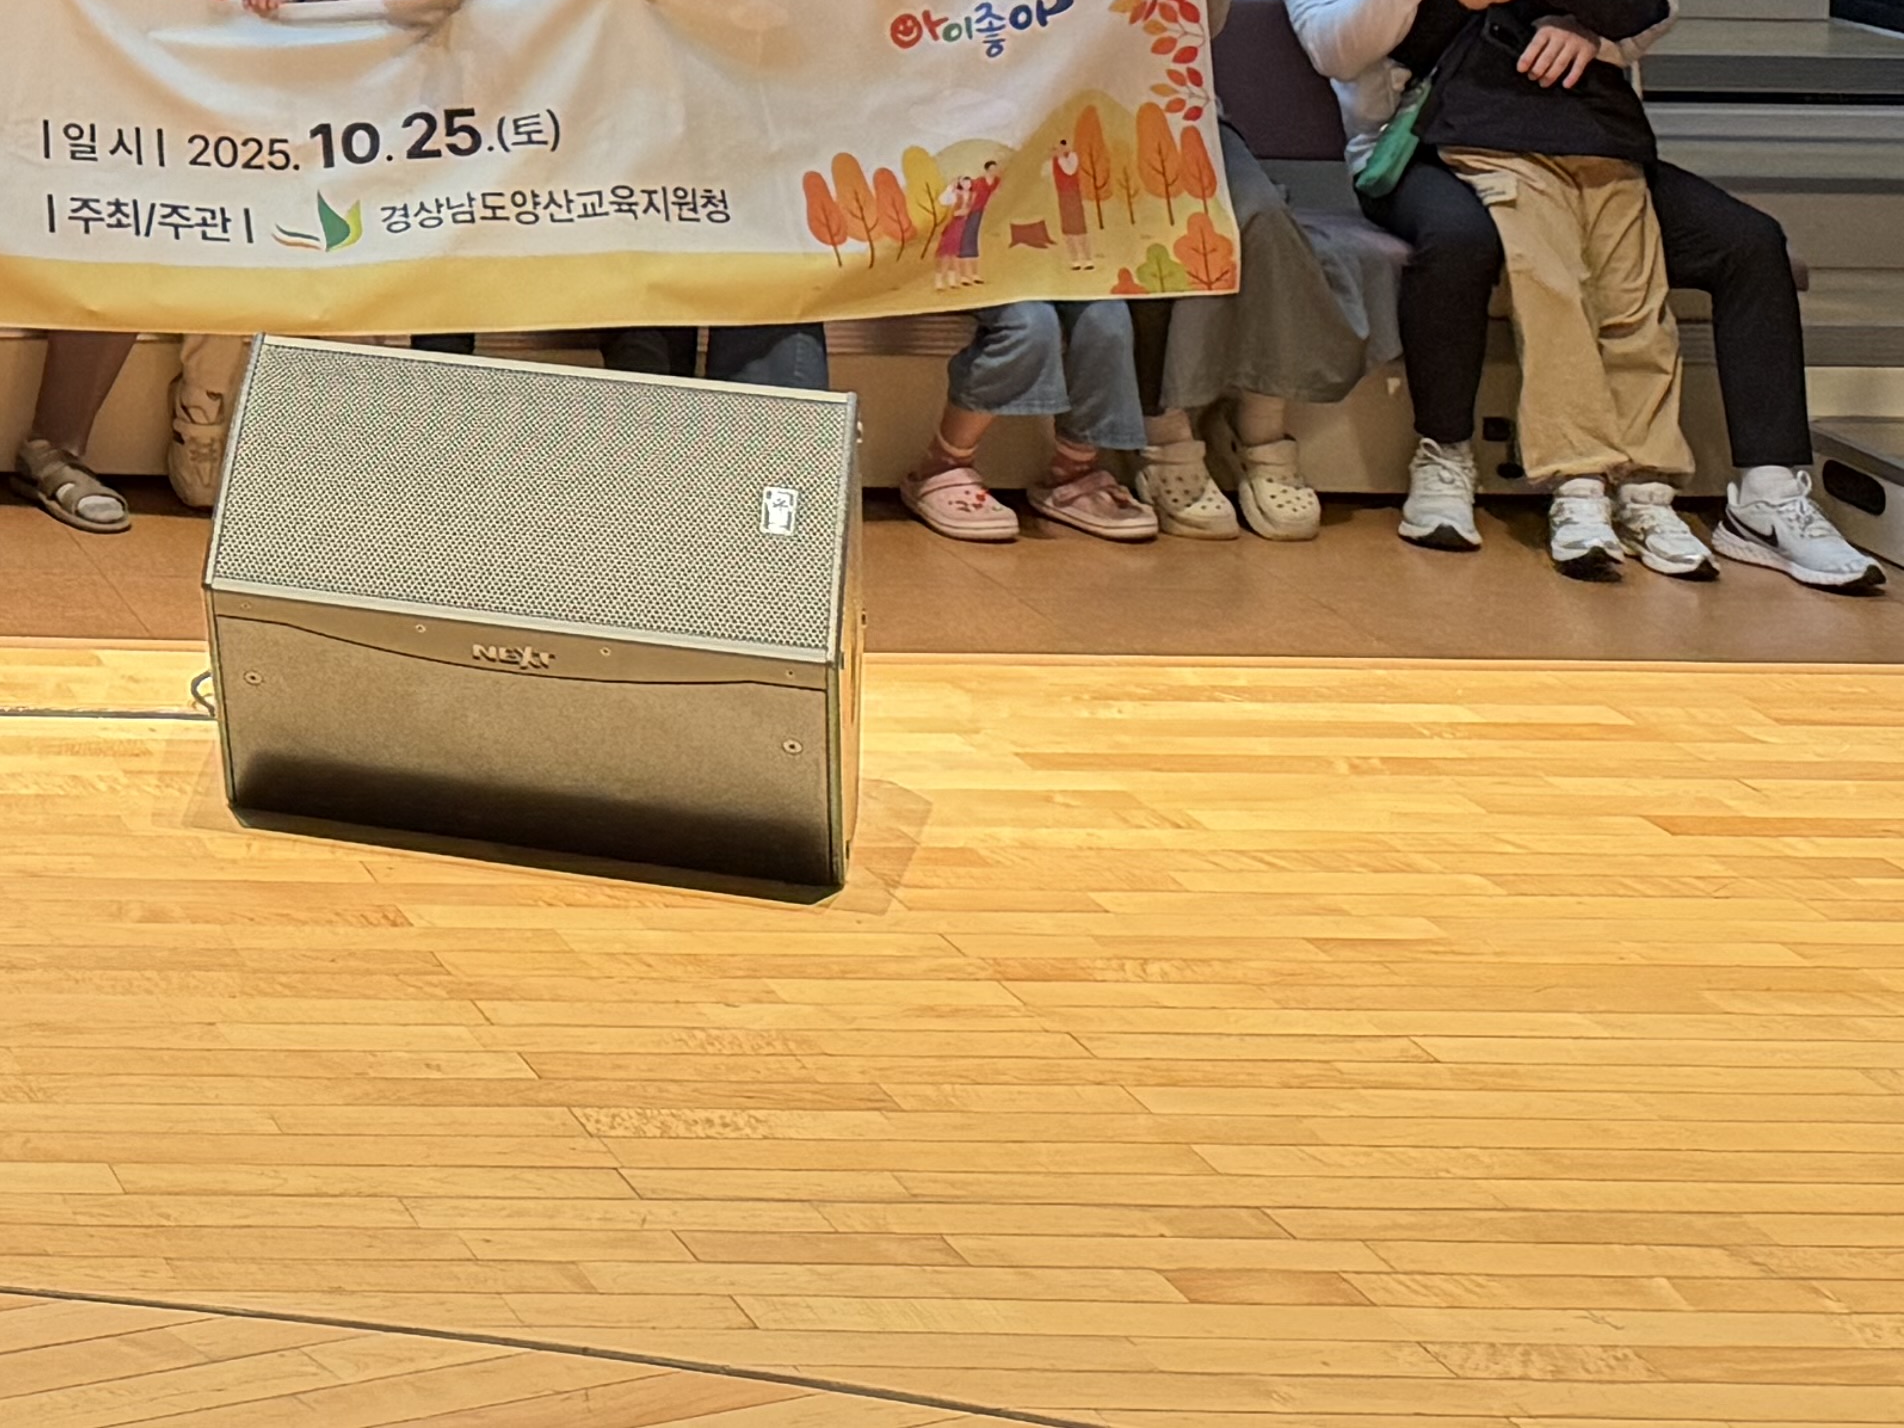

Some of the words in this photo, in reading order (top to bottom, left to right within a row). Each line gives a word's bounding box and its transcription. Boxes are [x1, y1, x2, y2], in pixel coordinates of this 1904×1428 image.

[187, 134, 302, 172] 2025.
[380, 185, 732, 236] 경상남도양산교육지원청
[472, 643, 558, 670] NEXT
